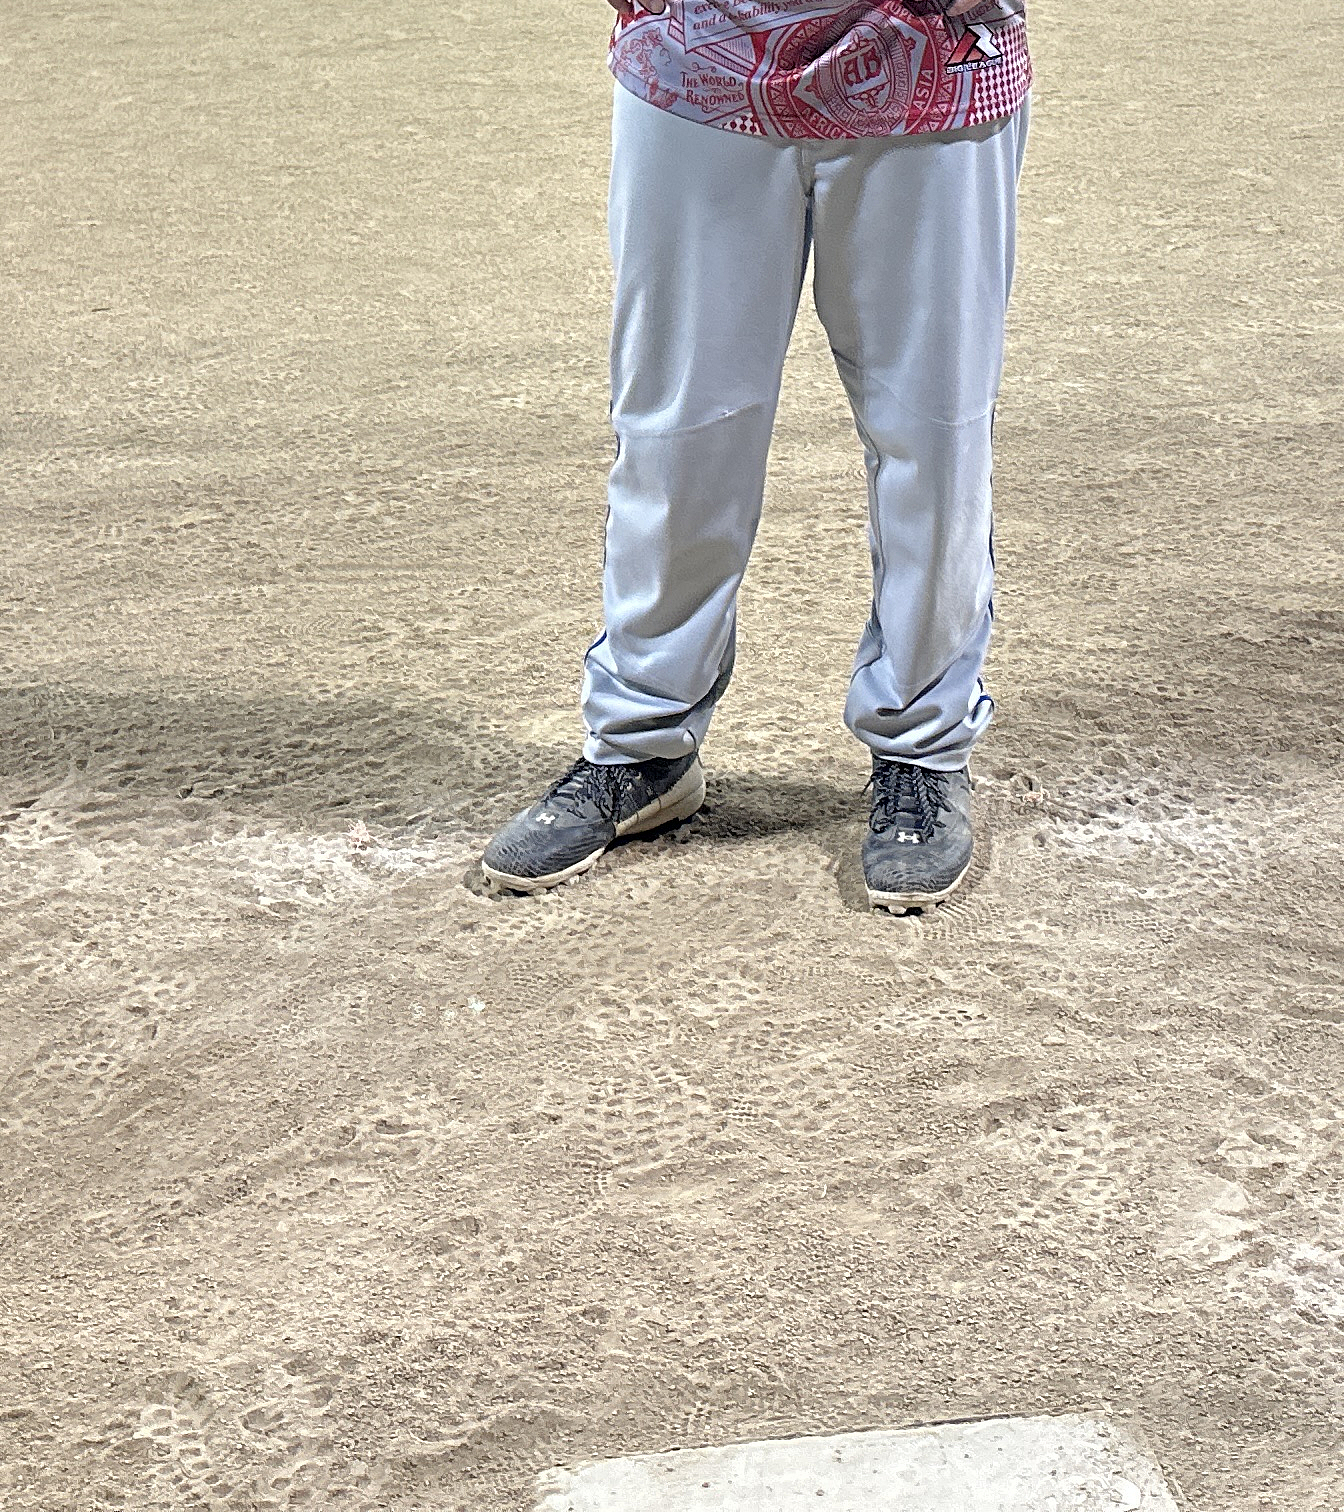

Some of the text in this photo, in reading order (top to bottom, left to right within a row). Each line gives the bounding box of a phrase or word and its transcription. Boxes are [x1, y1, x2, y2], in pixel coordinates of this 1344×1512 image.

[693, 14, 717, 30] and
[679, 71, 737, 88] THE WORLD
[685, 89, 745, 106] RENOWNED
[912, 68, 934, 111] ASIA
[800, 107, 850, 139] AFRICA
